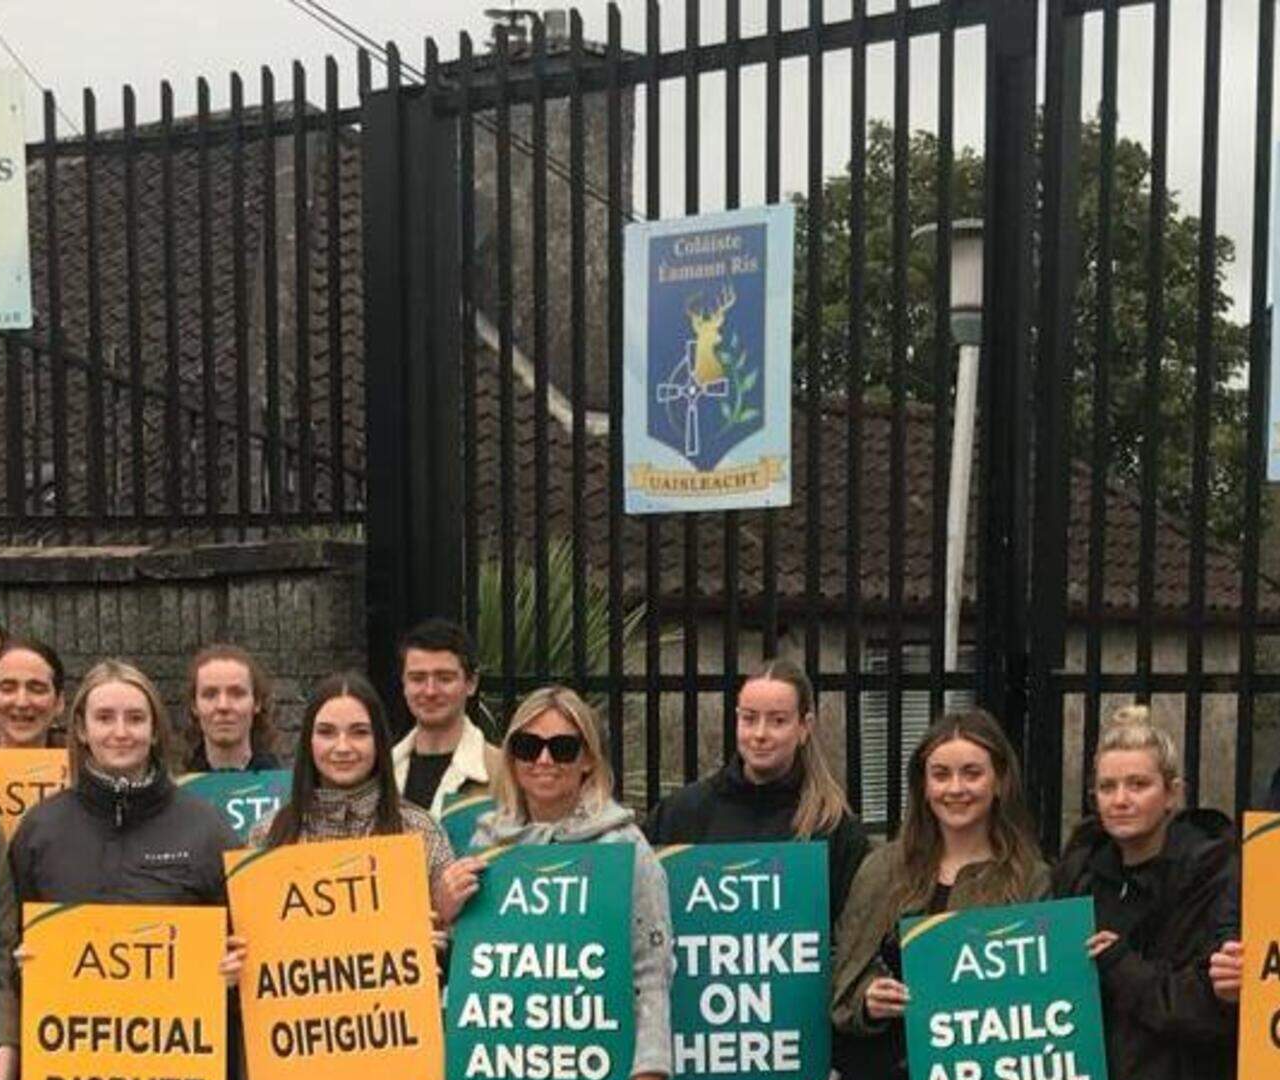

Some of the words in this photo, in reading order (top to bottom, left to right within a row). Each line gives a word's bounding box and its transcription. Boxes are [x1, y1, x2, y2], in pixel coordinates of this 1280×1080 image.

[674, 233, 742, 256] Coláiste
[650, 471, 758, 492] UAISLEACHT
[227, 797, 279, 830] ST
[281, 874, 380, 920] ASTI
[500, 876, 589, 916] ASTI
[686, 875, 780, 913] ASTI
[73, 942, 175, 980] ASTI
[257, 947, 420, 1000] AIGHNEAS
[469, 943, 606, 979] STAILC
[672, 932, 820, 976] TRIKE
[951, 936, 1047, 982] ASTI
[458, 993, 513, 1030] AR
[525, 982, 618, 1031] SIÚL
[699, 983, 771, 1024] ON
[37, 1015, 213, 1055] OFFICIAL
[271, 1003, 418, 1058] OIFIGIÚIL
[929, 1001, 1075, 1050] STAILC
[465, 1045, 610, 1080] ANSEO
[674, 1031, 801, 1074] HERE
